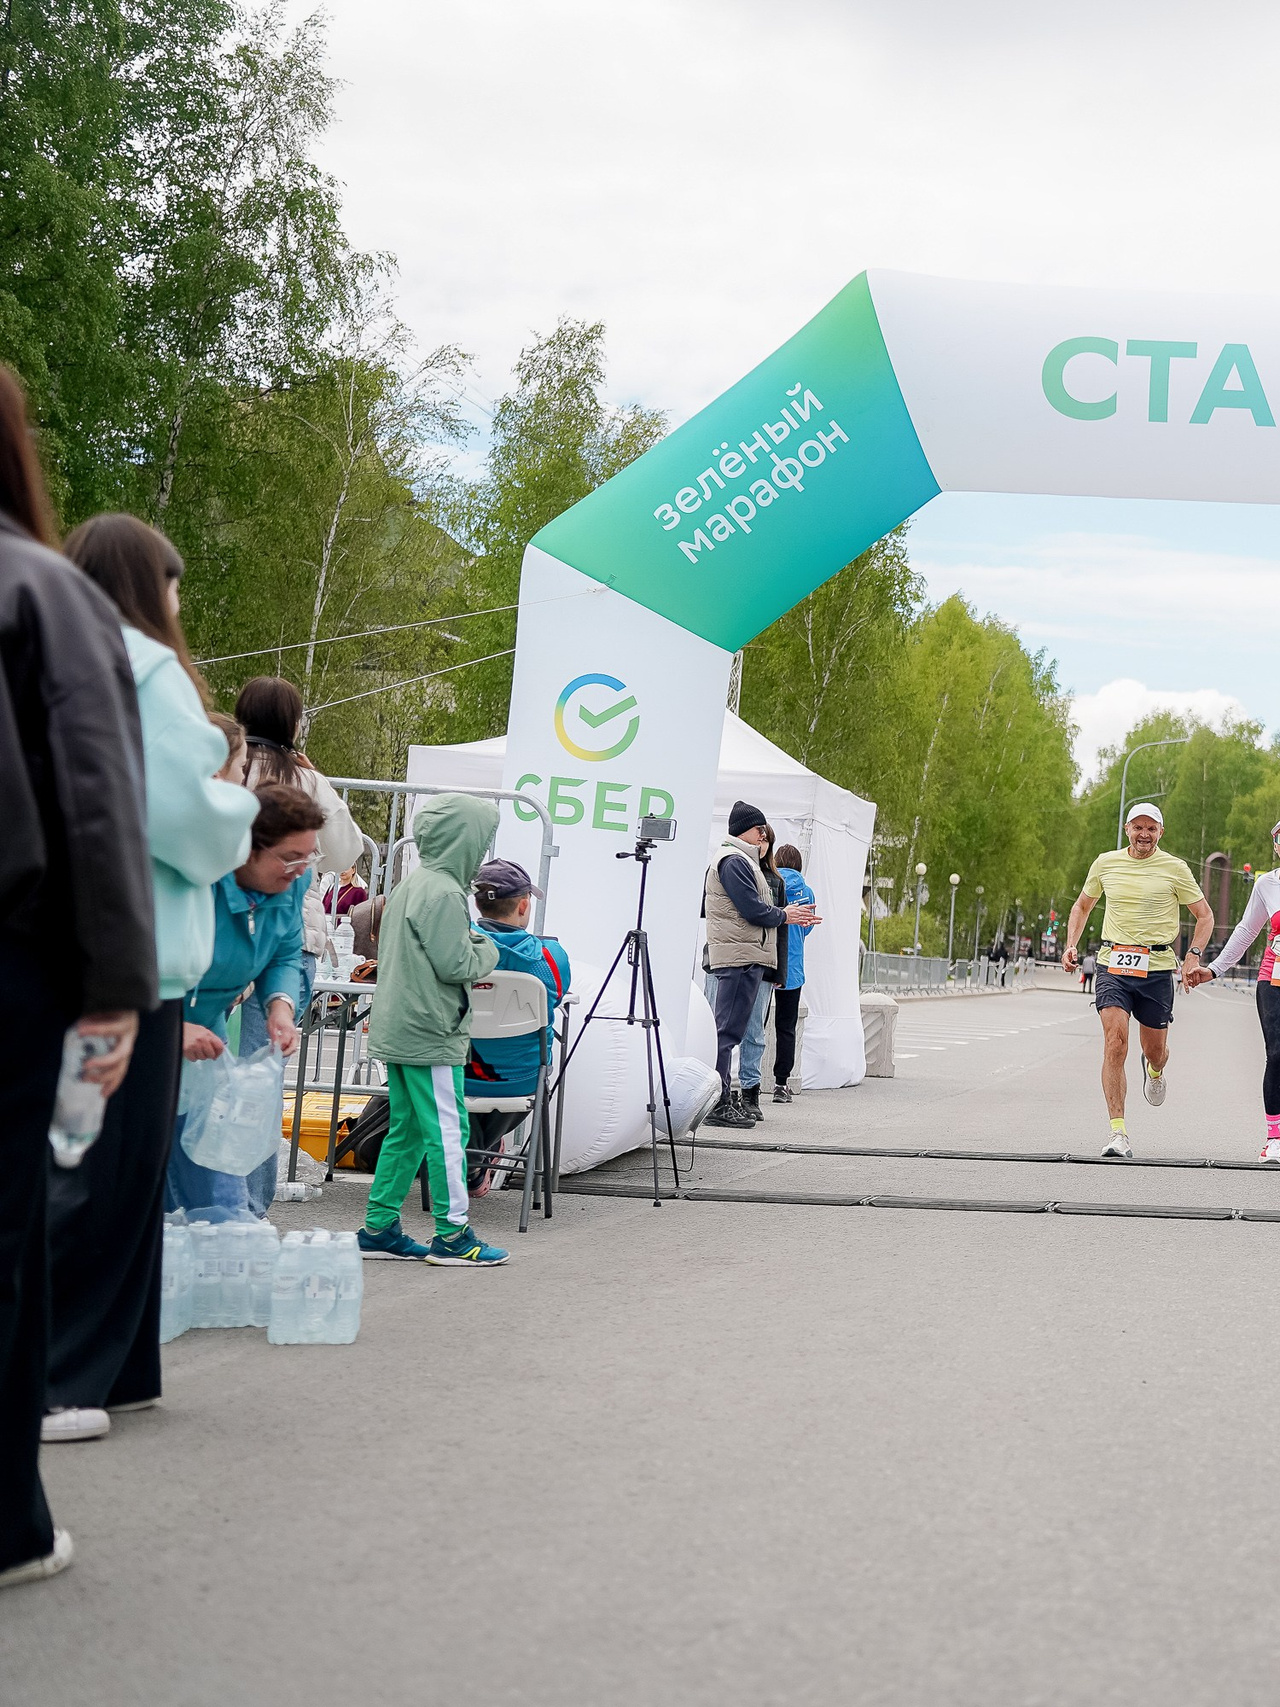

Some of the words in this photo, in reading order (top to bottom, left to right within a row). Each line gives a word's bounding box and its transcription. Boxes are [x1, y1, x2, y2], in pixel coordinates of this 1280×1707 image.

[653, 382, 824, 531] зелёный
[677, 419, 850, 565] марафон
[513, 773, 675, 832] СБЕР
[1116, 953, 1142, 967] 237
